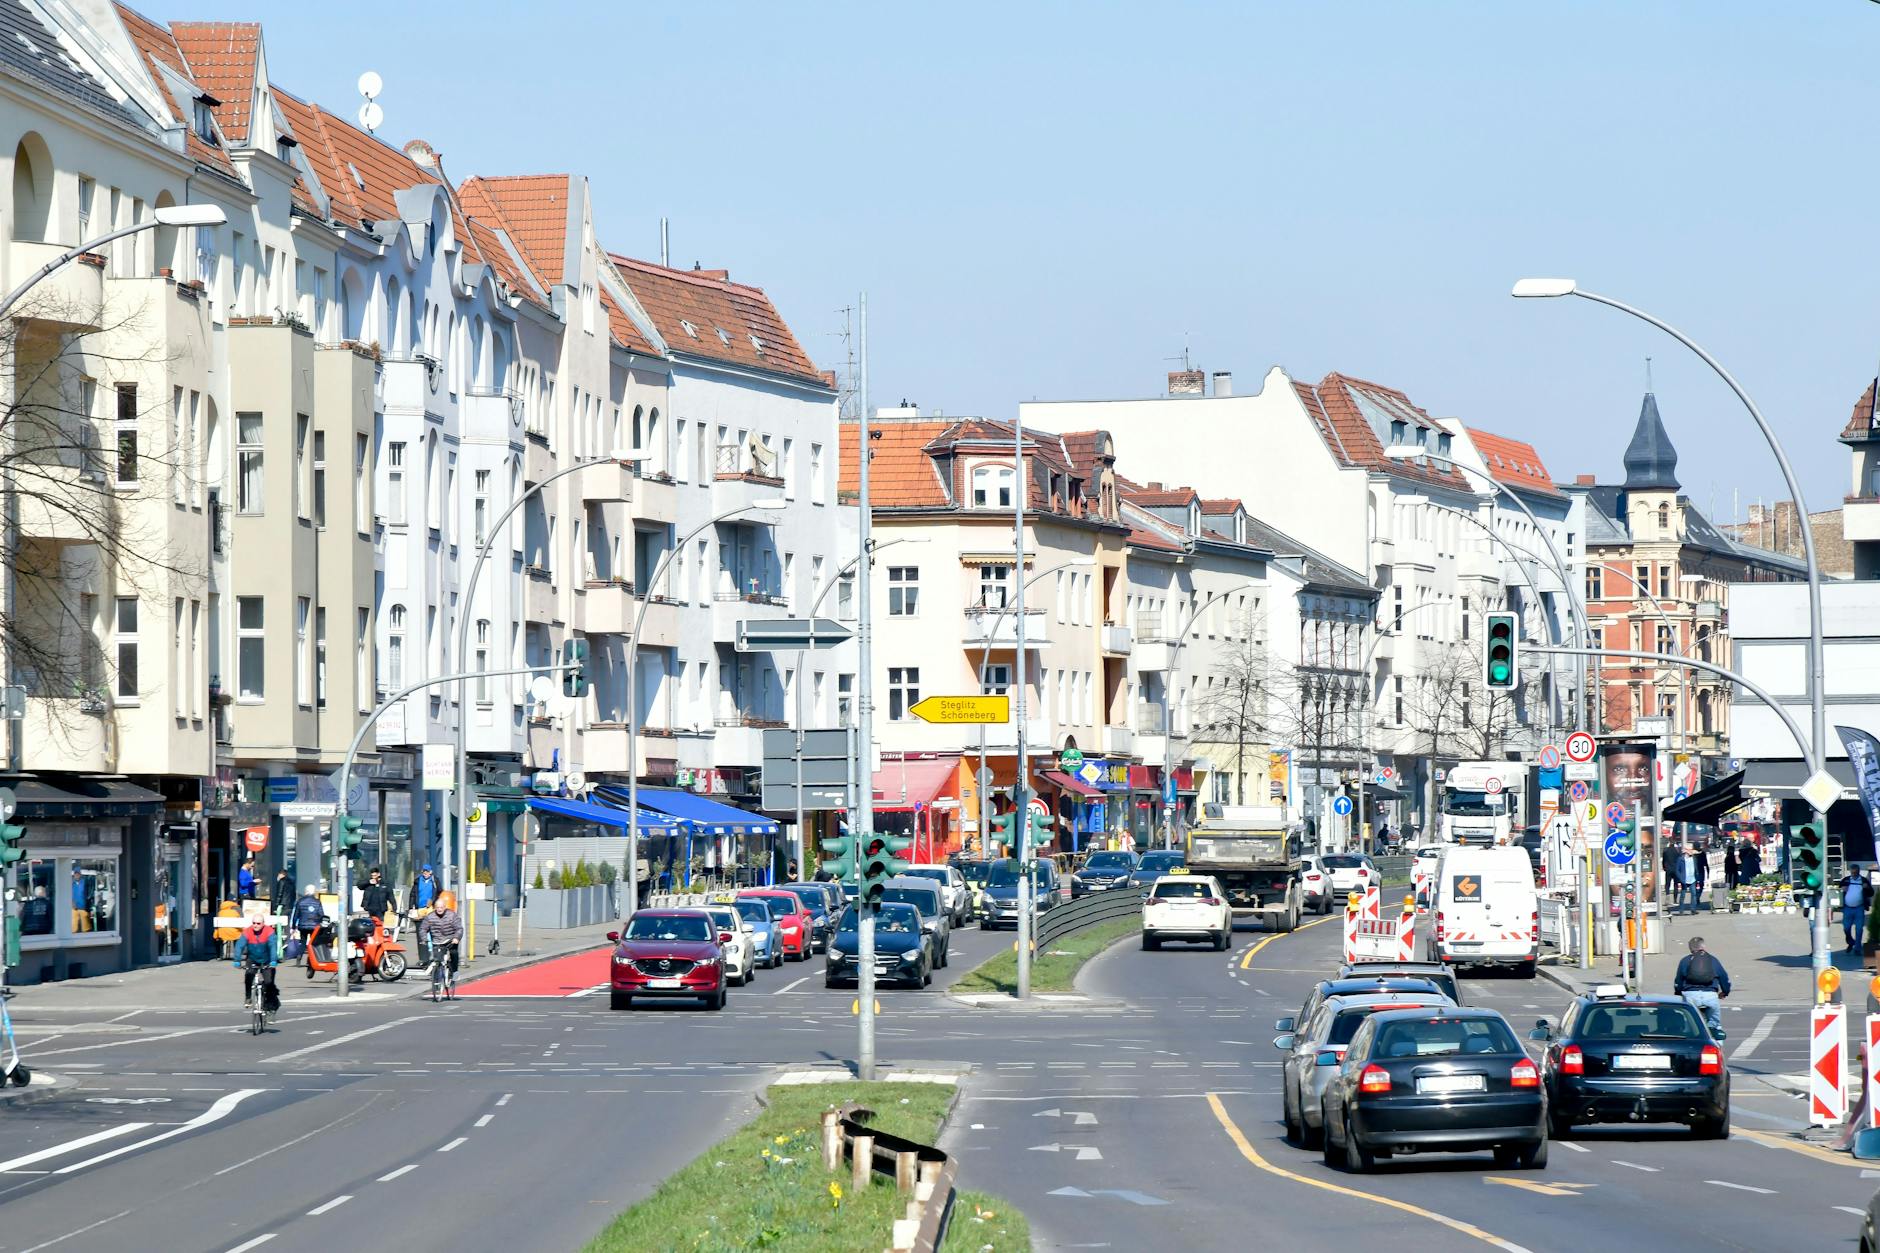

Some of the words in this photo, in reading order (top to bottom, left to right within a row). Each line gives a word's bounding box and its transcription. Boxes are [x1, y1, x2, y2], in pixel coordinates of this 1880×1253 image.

[941, 700, 976, 710] Steglitz
[941, 710, 996, 721] Schöneberg
[1572, 740, 1589, 754] 30
[1489, 781, 1499, 789] 30
